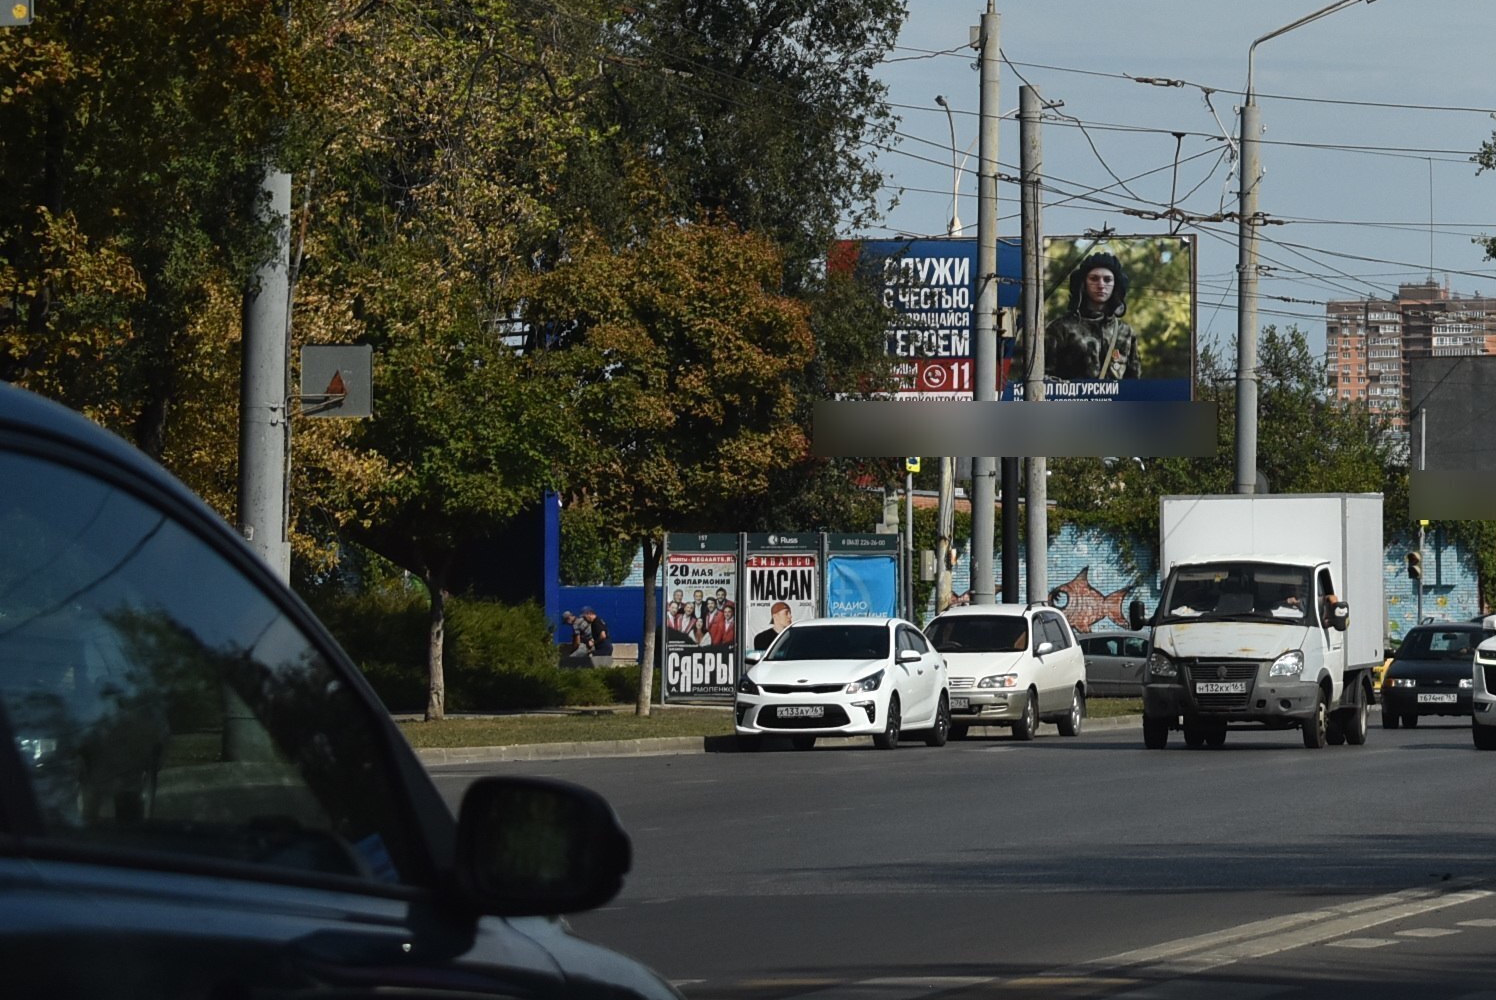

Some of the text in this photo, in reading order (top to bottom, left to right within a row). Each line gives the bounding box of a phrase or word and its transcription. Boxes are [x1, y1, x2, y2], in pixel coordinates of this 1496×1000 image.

[883, 288, 894, 309] С
[1055, 381, 1119, 396] ПОДГУРСКИЙ
[780, 536, 799, 544] Russ
[669, 564, 690, 577] 20
[691, 569, 713, 577] МАЯ
[673, 578, 731, 586] ФИЛАРМОНИЯ
[750, 569, 812, 601] MACAN
[832, 601, 868, 611] РАДИО
[667, 652, 734, 693] СЯБРЫ
